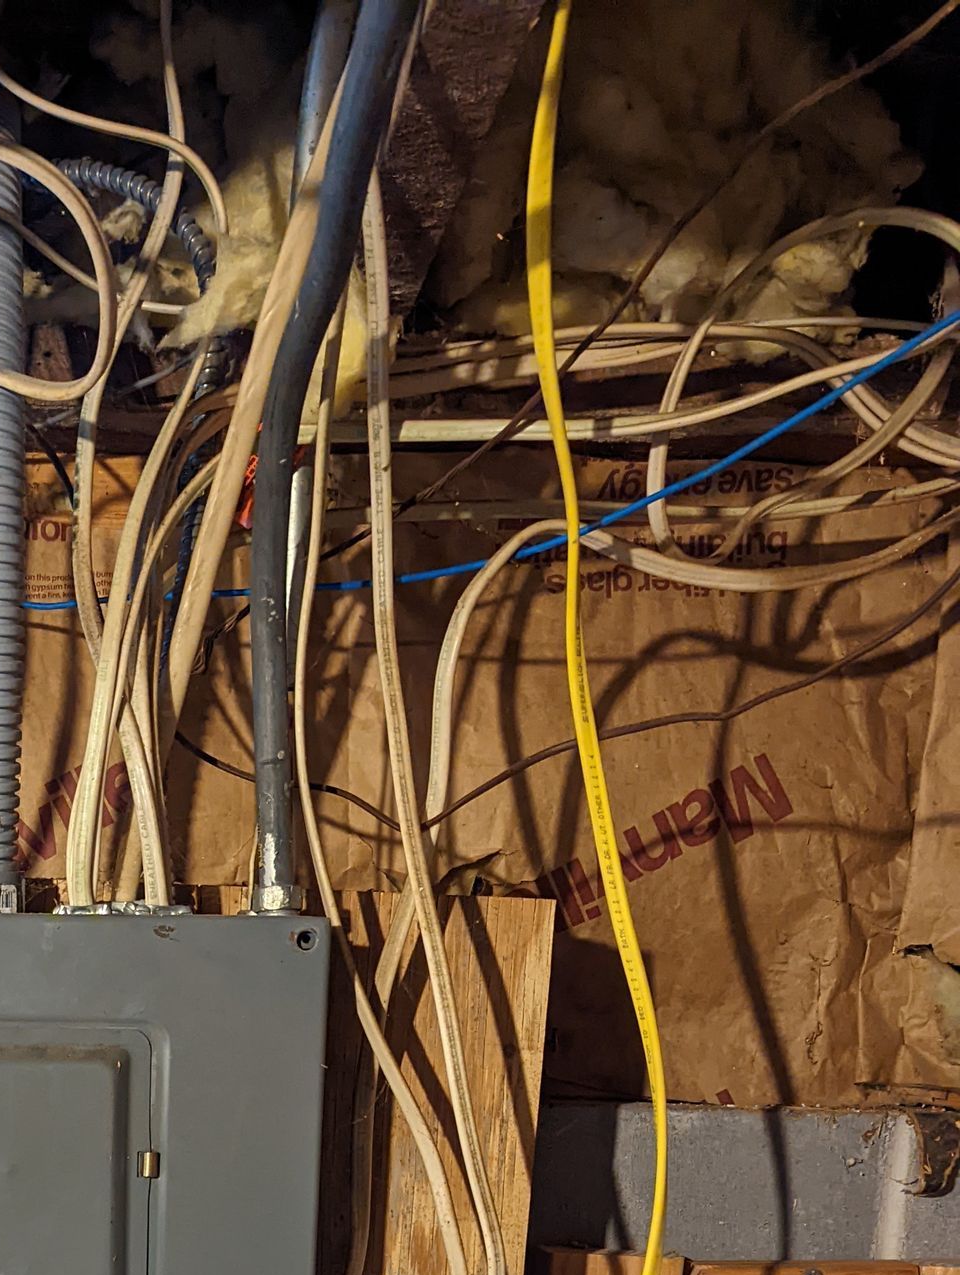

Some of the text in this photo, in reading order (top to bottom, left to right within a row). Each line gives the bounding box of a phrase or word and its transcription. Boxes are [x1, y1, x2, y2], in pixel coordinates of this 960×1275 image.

[717, 466, 794, 494] save
[31, 583, 63, 592] gypsum
[595, 794, 605, 820] OTHER
